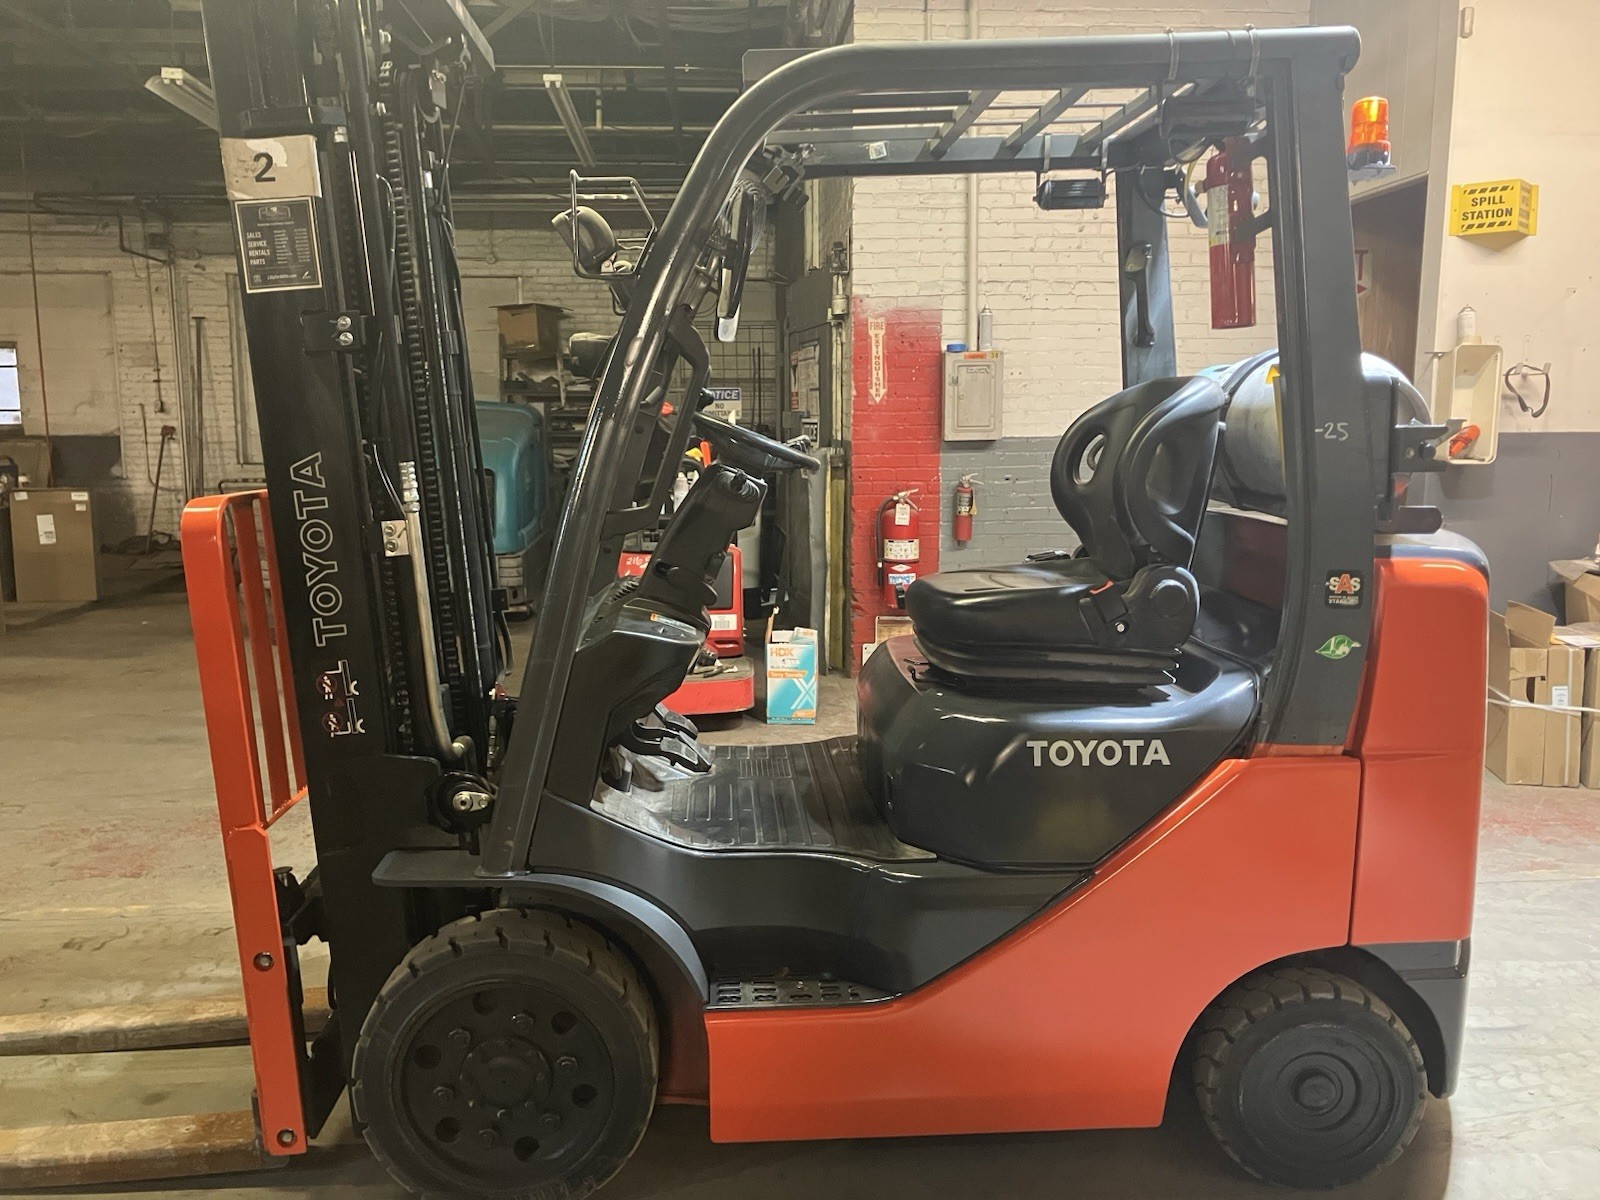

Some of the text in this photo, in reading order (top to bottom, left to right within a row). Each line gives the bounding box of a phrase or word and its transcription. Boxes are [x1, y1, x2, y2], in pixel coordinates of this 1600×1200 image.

[253, 152, 276, 182] 2
[1471, 195, 1506, 206] SPILL
[1462, 207, 1513, 221] STATION
[869, 321, 884, 331] FIRE
[711, 390, 739, 400] TICE
[715, 402, 725, 410] NO
[289, 451, 348, 647] TOYOTA
[1328, 573, 1361, 595] SAS
[770, 647, 794, 657] HDX
[1026, 739, 1171, 767] TOYOTA
